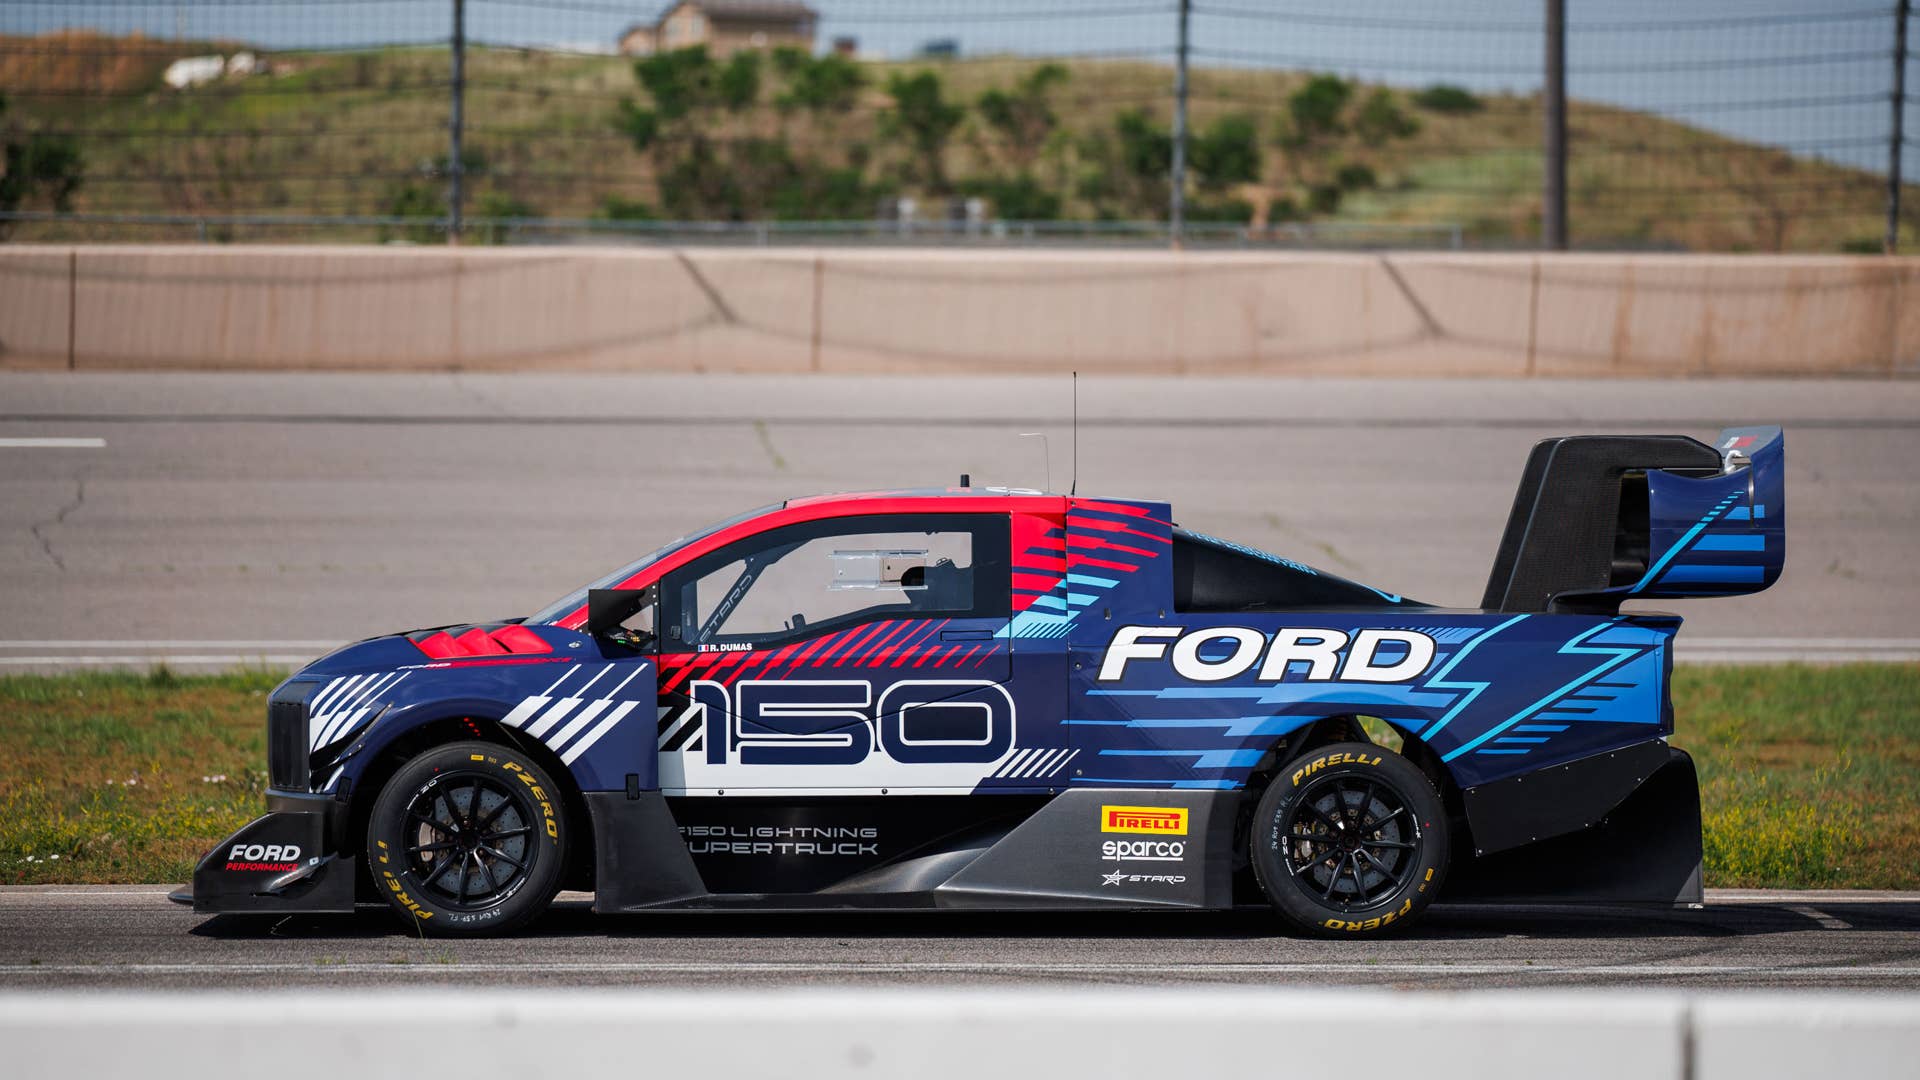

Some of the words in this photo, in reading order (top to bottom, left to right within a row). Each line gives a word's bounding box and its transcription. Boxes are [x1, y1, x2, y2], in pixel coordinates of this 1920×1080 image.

[710, 644, 719, 652] R.
[720, 643, 753, 652] DUMAS
[1096, 624, 1437, 682] FORD
[690, 679, 1016, 765] 150
[1292, 753, 1383, 787] PIRELLI
[1108, 811, 1181, 829] PIRELLI
[731, 827, 878, 838] LIGHTNING
[228, 844, 301, 861] FORD
[684, 842, 878, 856] UPERTRUCK
[1102, 840, 1184, 862] sparco
[226, 862, 299, 872] PERFORMANCE
[1128, 874, 1187, 885] STARD
